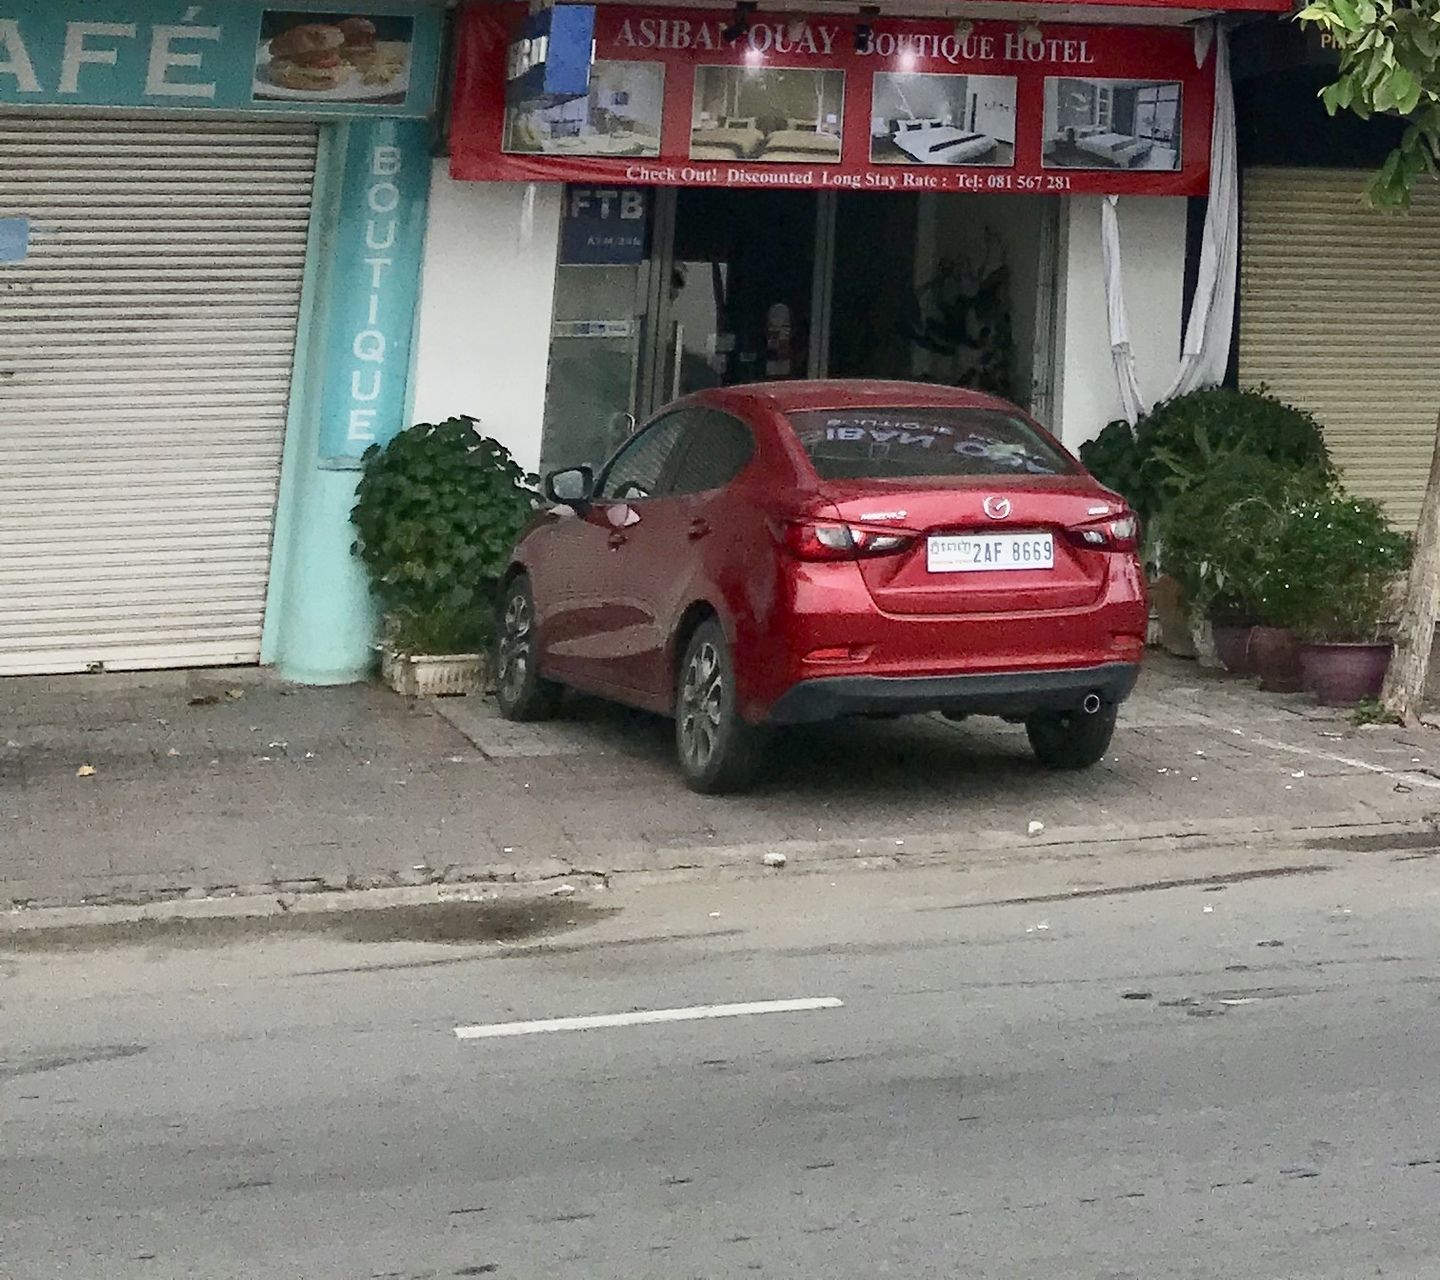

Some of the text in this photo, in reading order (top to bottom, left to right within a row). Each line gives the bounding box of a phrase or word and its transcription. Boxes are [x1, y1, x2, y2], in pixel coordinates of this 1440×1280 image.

[747, 22, 839, 58] QUAY
[626, 166, 676, 181] Check
[681, 167, 717, 182] Out!
[727, 168, 813, 184] Discounted
[822, 171, 862, 190] Long
[865, 171, 898, 189] Stay
[956, 173, 983, 191] Tel:
[987, 174, 1012, 188] 081
[1017, 175, 1043, 189] 567
[1047, 176, 1071, 190] 281
[572, 191, 643, 219] FTB
[347, 146, 401, 441] BOUTIQUE
[973, 541, 1052, 563] 2AF 8669
